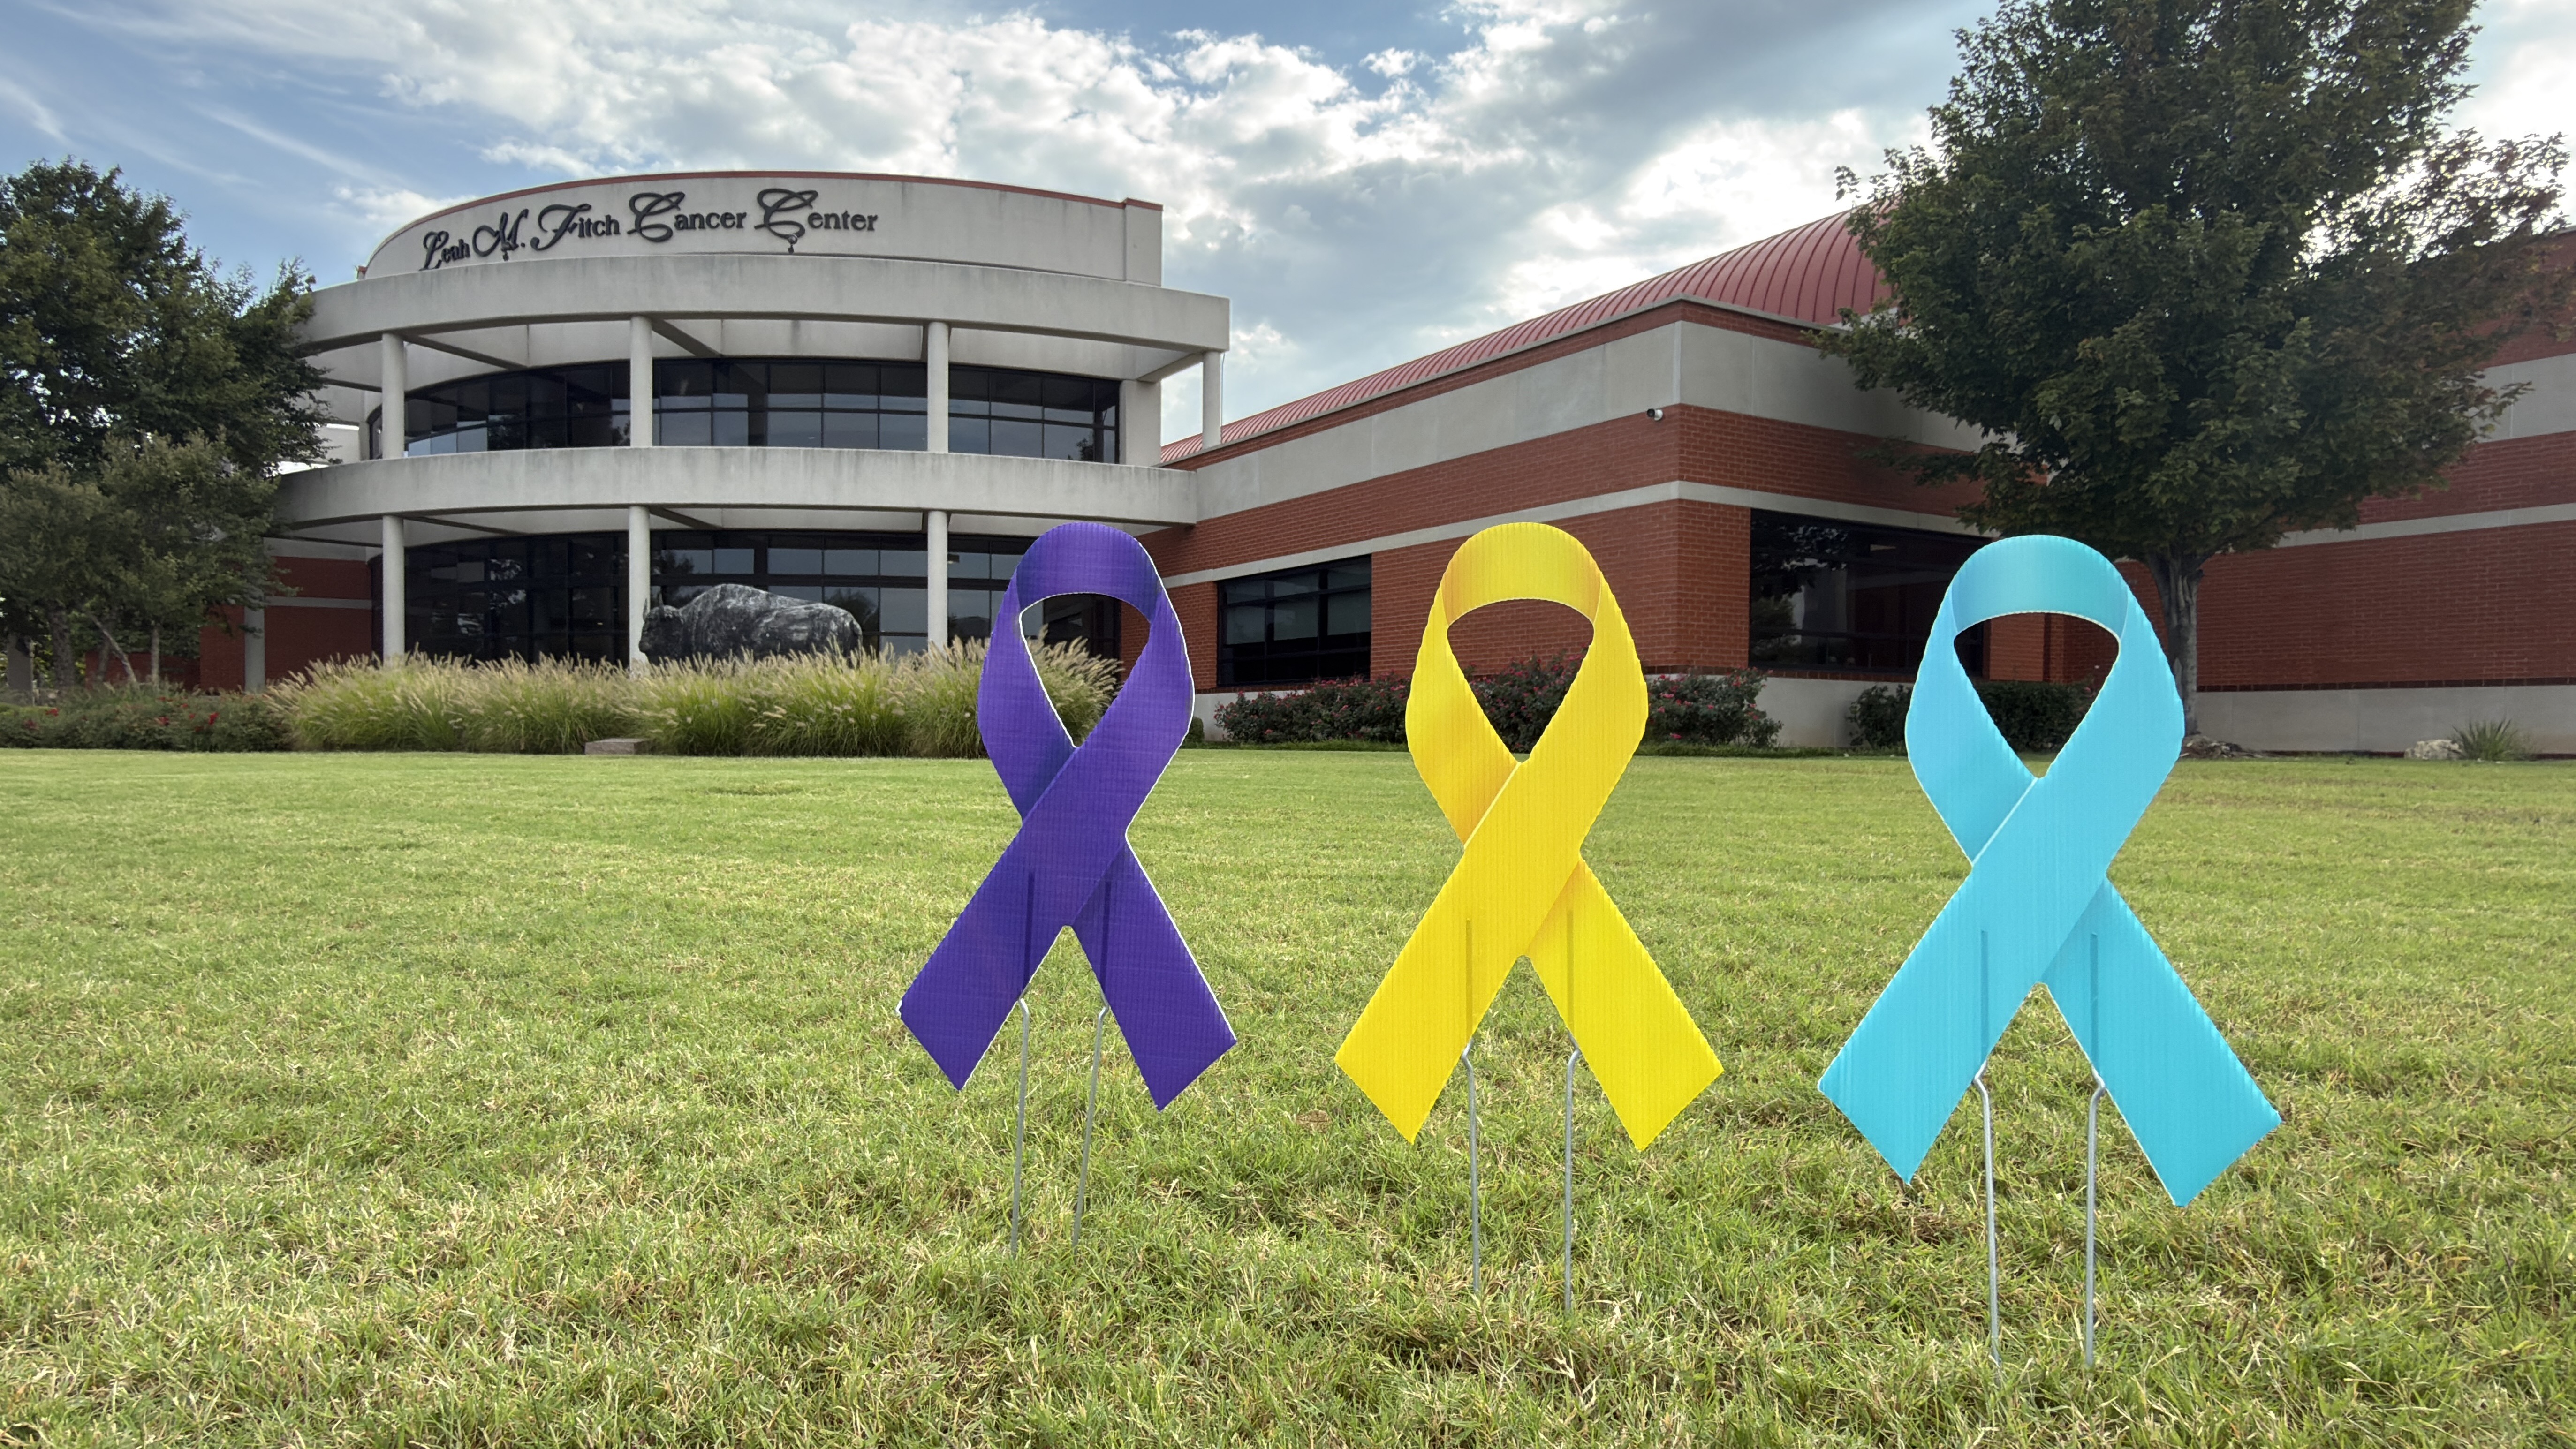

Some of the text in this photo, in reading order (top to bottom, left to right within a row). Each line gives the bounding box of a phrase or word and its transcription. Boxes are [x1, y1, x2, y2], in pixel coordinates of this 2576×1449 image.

[419, 188, 878, 271] Leah M. Fitch Cancer Center
